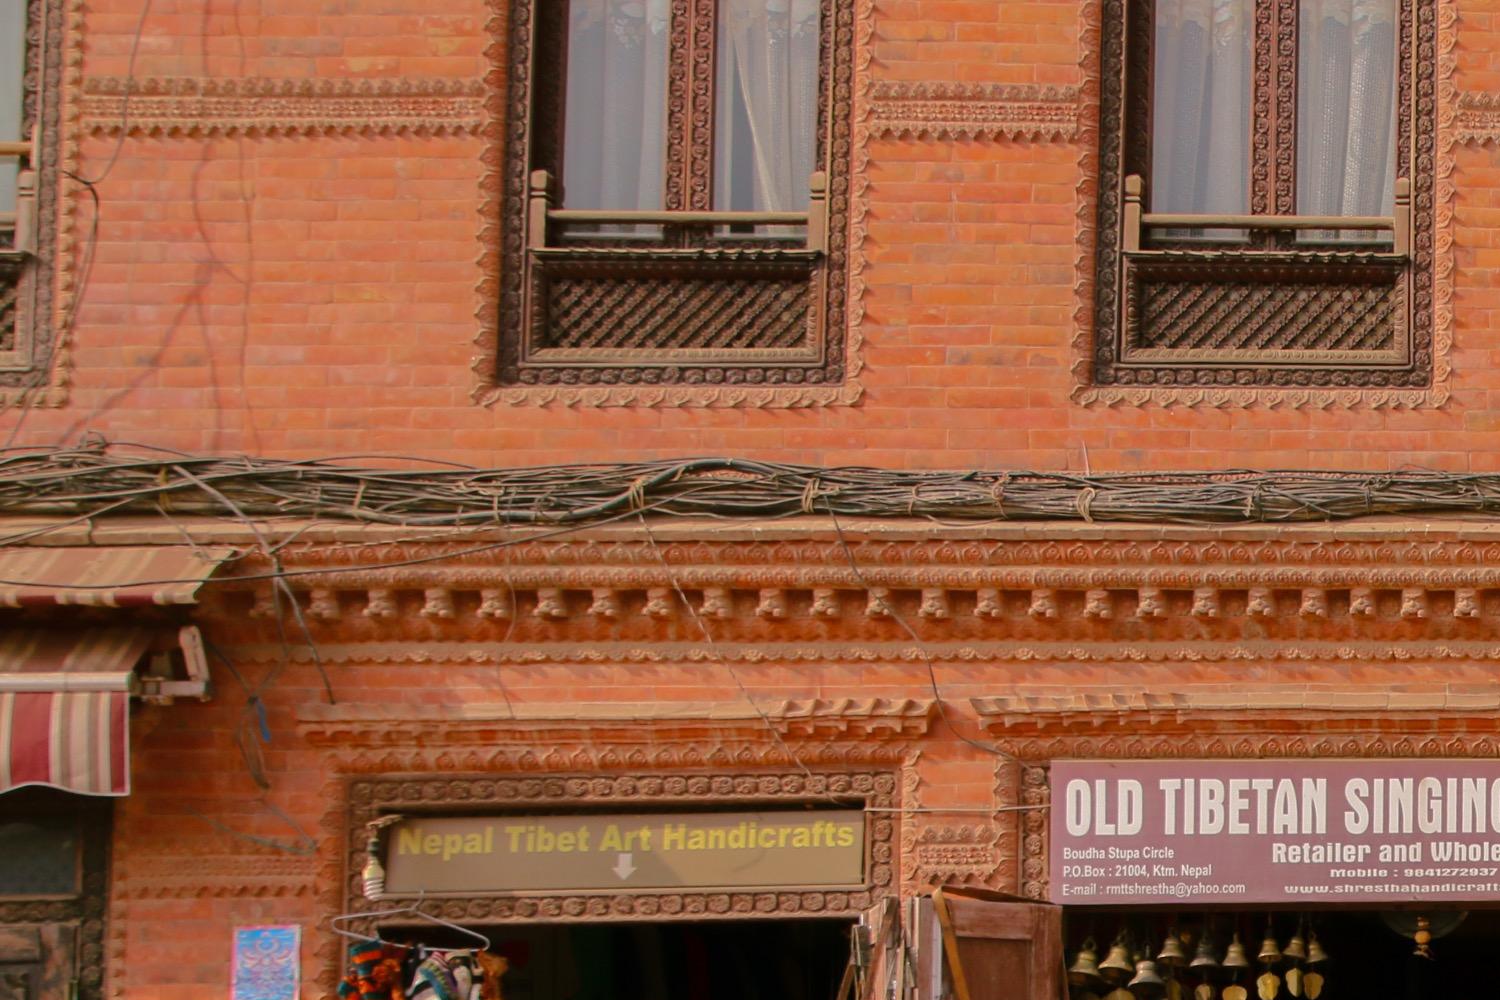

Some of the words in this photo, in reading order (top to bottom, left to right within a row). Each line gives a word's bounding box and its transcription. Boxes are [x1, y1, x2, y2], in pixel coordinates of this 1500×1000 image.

[1065, 778, 1143, 837] OLD
[1159, 778, 1327, 835] TIBETAN
[398, 823, 494, 861] Nepal
[504, 823, 590, 854] Tibet
[601, 824, 652, 852] Art
[662, 819, 855, 853] Handicrafts
[1063, 847, 1106, 860] Boudha
[1108, 847, 1140, 862] Stupa
[1142, 846, 1175, 859] Circle
[1271, 842, 1371, 864] Retailer
[1378, 842, 1422, 863] and
[1063, 865, 1106, 878] P.O.Box
[1115, 865, 1150, 878] 21004,
[1152, 865, 1179, 877] Ktm.
[1181, 864, 1212, 878] Nepal
[1329, 868, 1388, 878] Mobile
[1403, 868, 1498, 878] 9841272937
[1062, 883, 1097, 896] E-mail
